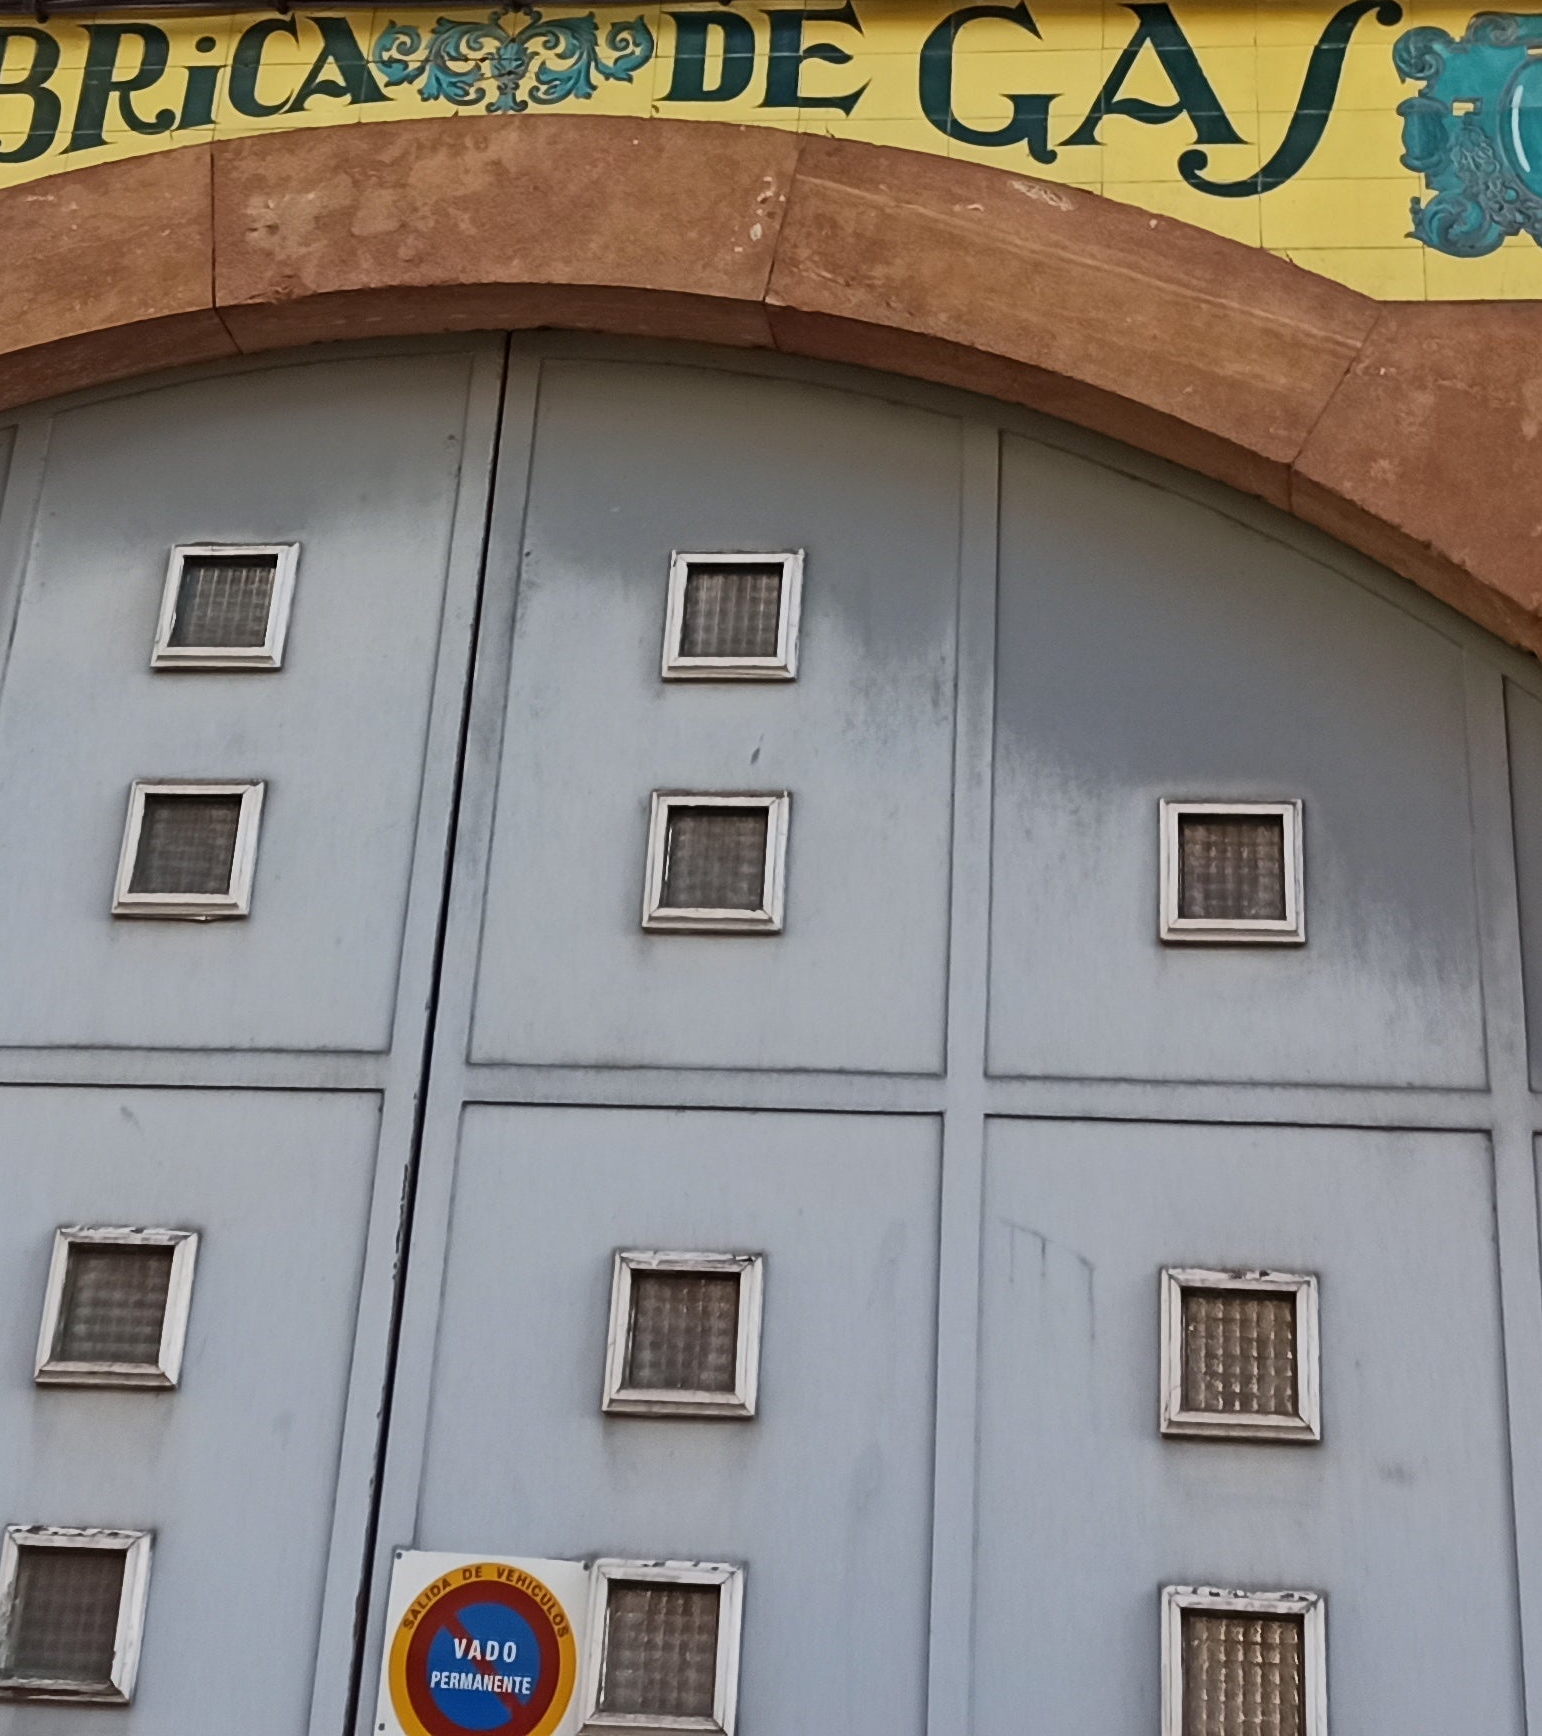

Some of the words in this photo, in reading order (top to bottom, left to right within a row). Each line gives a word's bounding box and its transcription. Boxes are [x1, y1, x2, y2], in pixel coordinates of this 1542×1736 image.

[402, 1577, 453, 1630] SALIDA
[461, 1565, 483, 1582] DE
[496, 1566, 571, 1639] VEHICULOS
[453, 1637, 517, 1663] VADO
[429, 1670, 532, 1695] PERMANENTE
